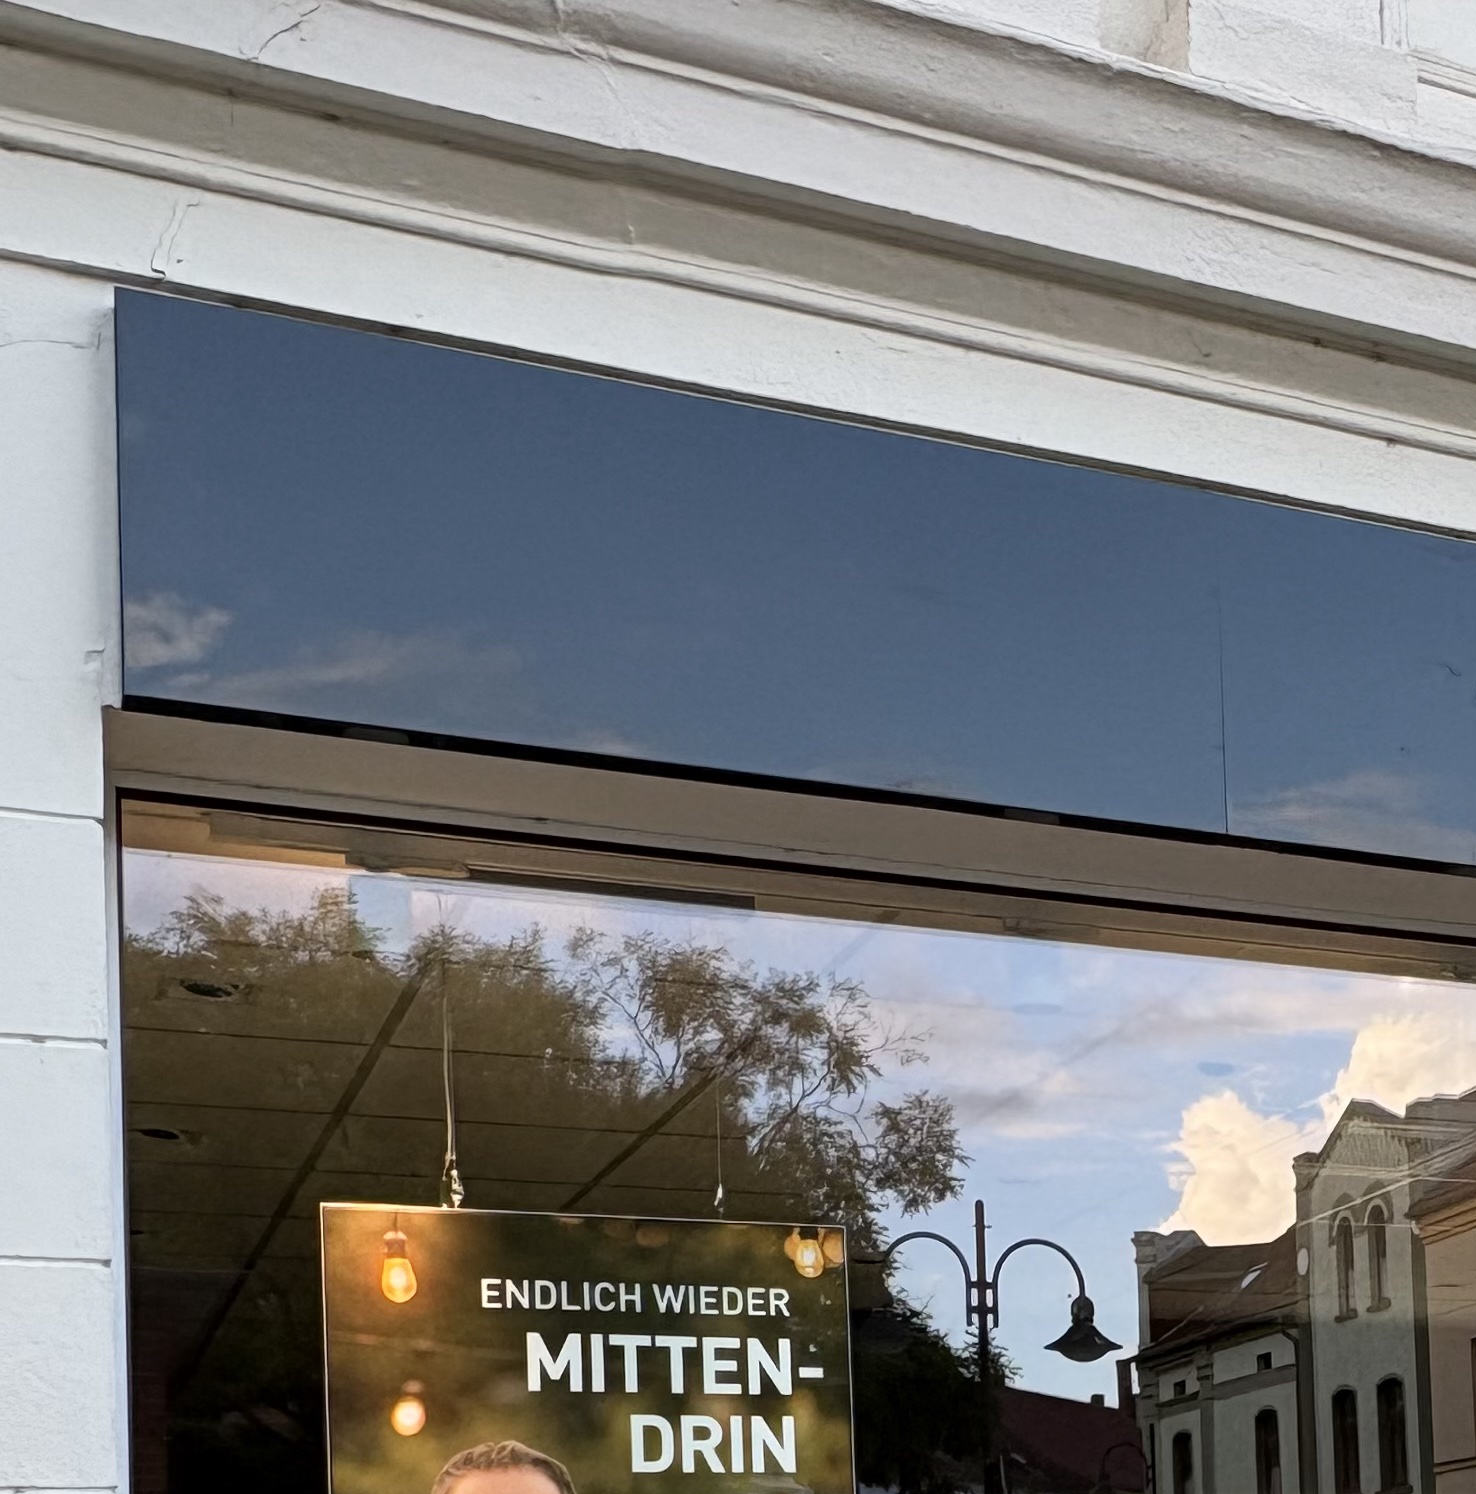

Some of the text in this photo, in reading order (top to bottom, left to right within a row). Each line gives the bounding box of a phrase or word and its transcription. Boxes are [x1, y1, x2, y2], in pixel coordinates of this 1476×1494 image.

[480, 1278, 791, 1318] ENDLICH WIEDER
[526, 1332, 825, 1396] MITTEN-
[630, 1414, 797, 1475] DRIN
